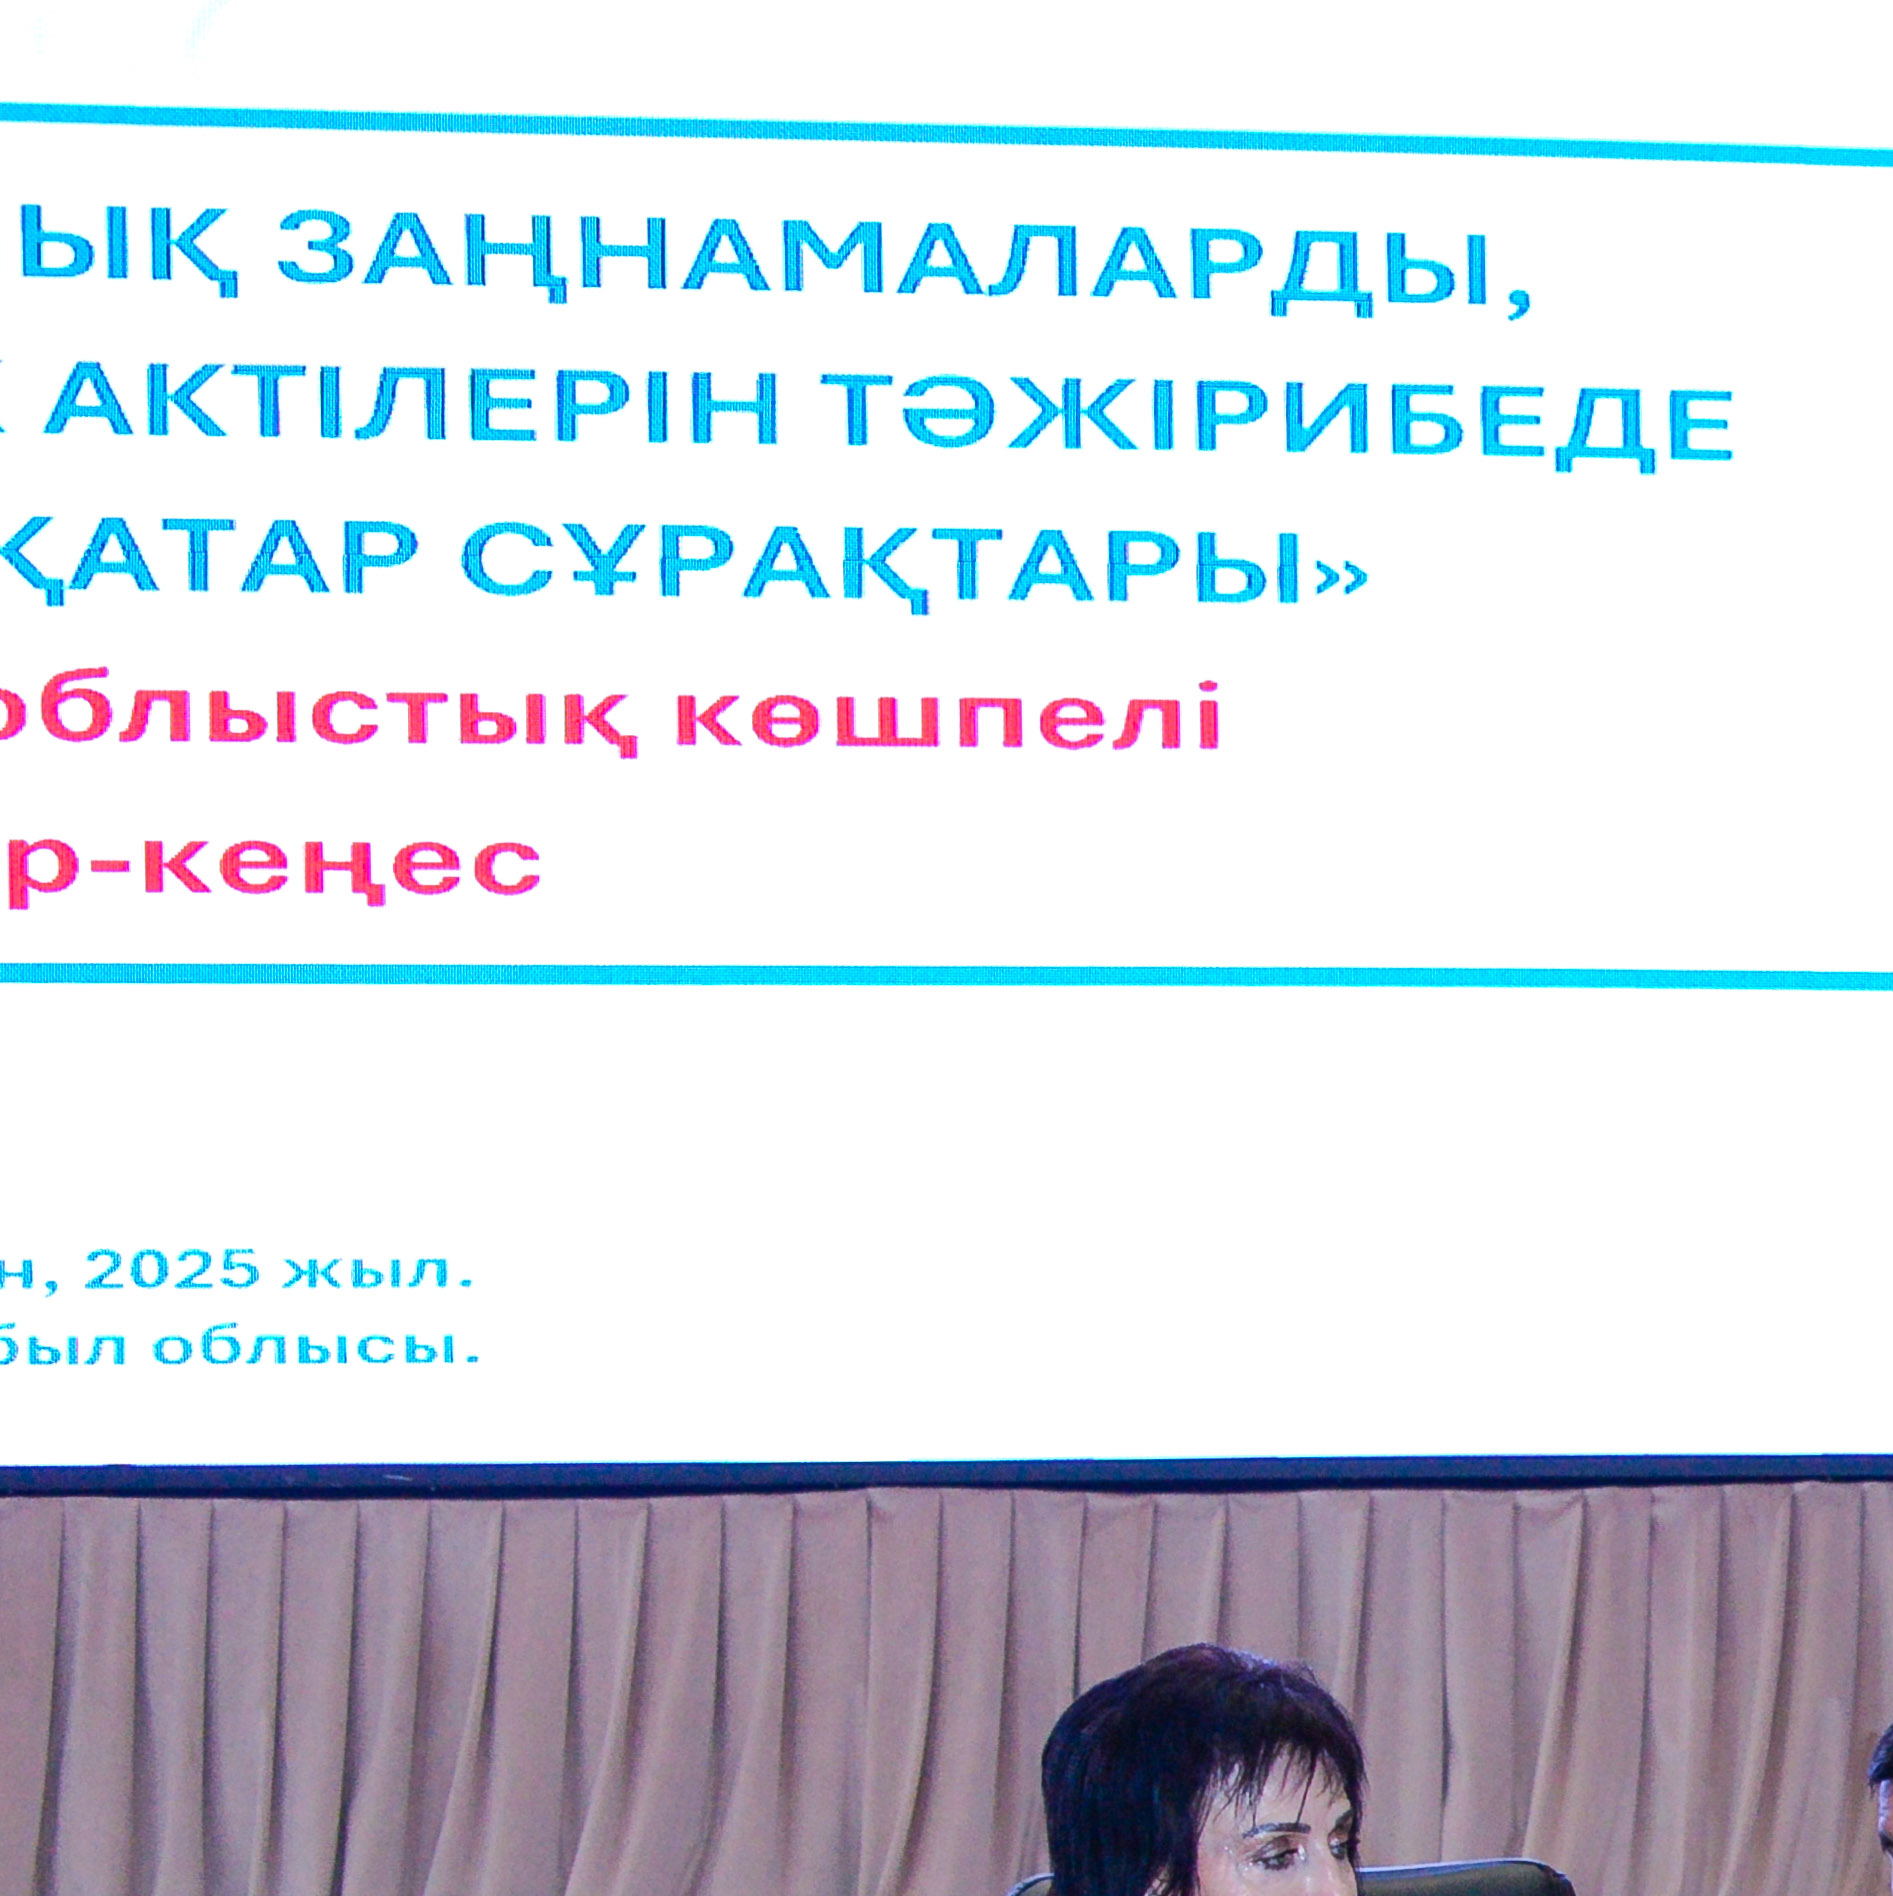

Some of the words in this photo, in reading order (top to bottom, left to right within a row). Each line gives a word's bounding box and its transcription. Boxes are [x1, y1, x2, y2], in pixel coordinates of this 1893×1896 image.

[21, 204, 238, 298] ЫҚ
[278, 209, 1530, 321] ЗАҢНАМАЛАРДЫ,
[43, 361, 777, 445] АКТІЛЕРІН
[820, 374, 1733, 475] ТӘЖІРИБЕДЕ
[461, 522, 1368, 616] СҰРАҚТАРЫ»
[677, 680, 1218, 750] көшпелі
[8, 839, 539, 910] р-кеңес
[85, 1249, 259, 1289] 2025
[283, 1259, 471, 1288] жыл.
[153, 1322, 478, 1364] облысы.
